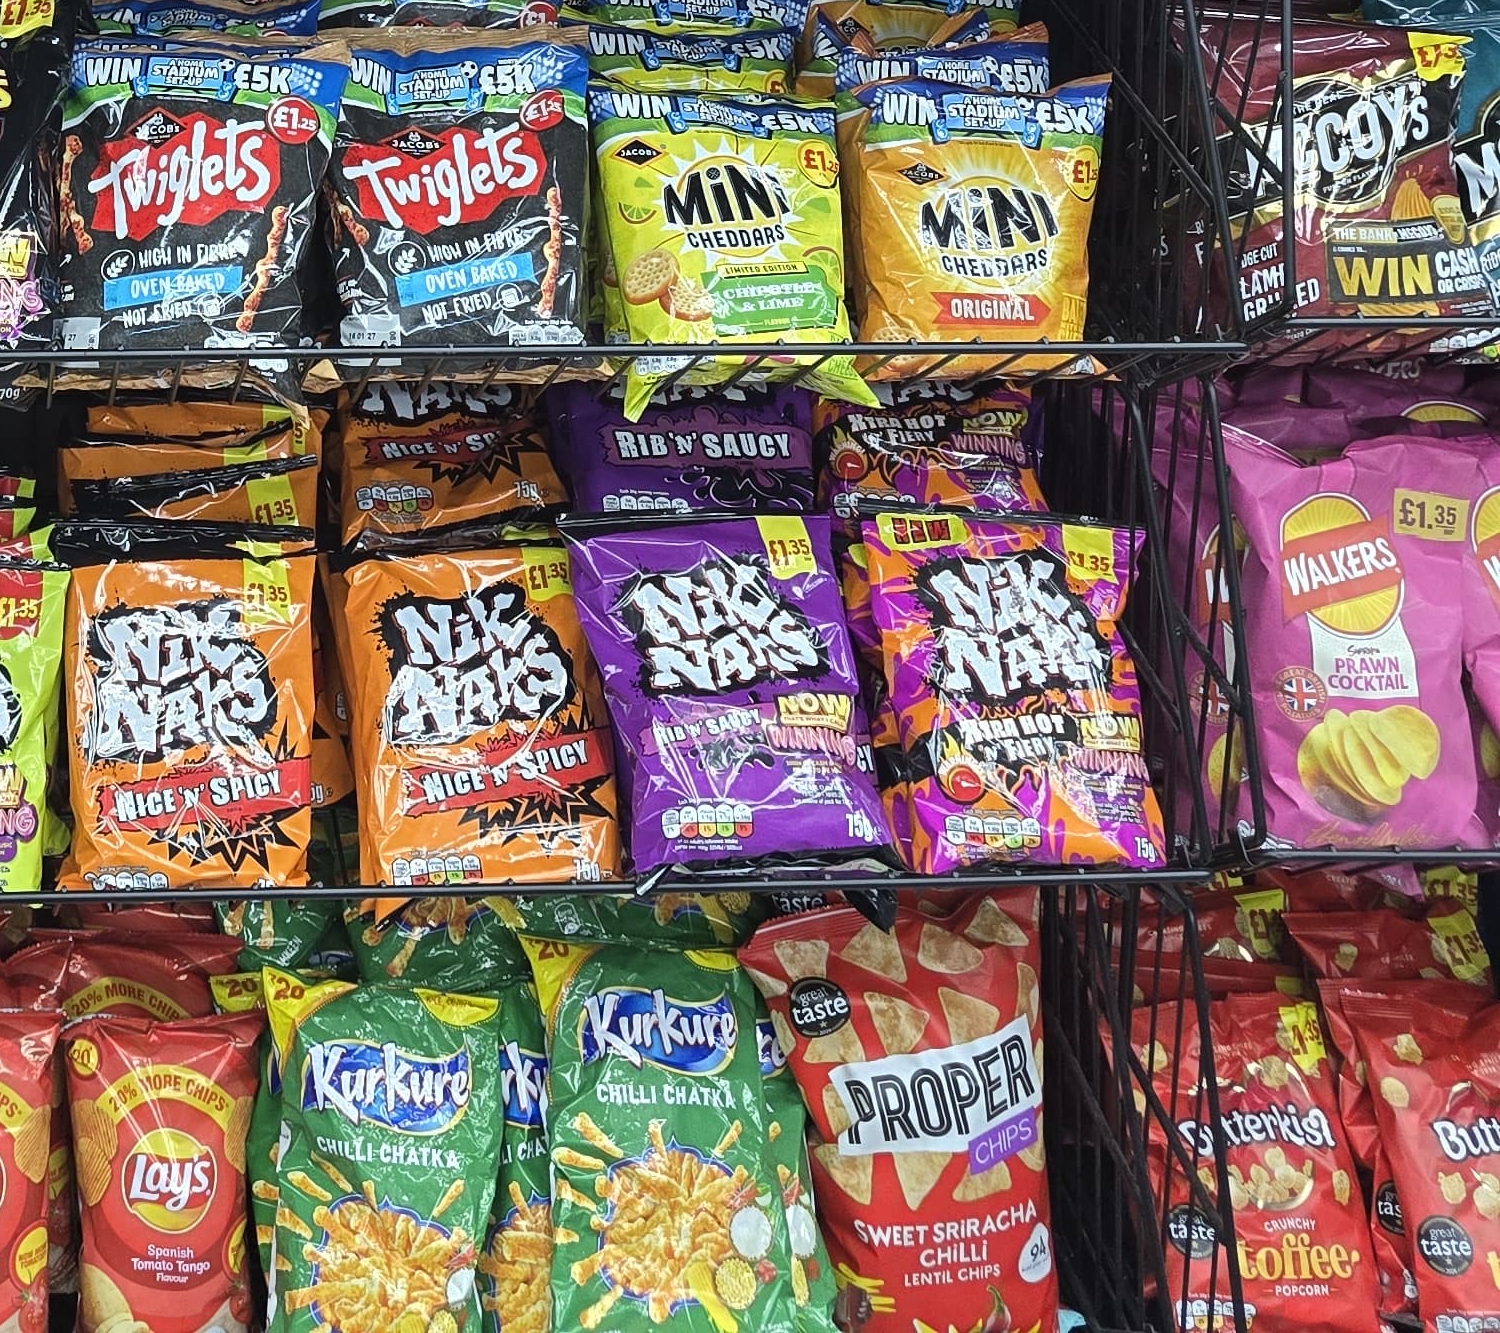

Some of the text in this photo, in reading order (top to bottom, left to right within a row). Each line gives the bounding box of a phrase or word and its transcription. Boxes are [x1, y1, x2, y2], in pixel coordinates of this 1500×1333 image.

[84, 57, 141, 86] WIN
[151, 64, 219, 82] STADIUM
[234, 66, 291, 94] £5K
[88, 119, 271, 239] Twiglets
[342, 124, 539, 230] Twiglets
[427, 237, 481, 264] HIGH IN
[686, 226, 785, 249] CHEDDARS
[424, 259, 518, 293] OVEN BAKED
[723, 262, 798, 276] LIMITED EDITION
[1435, 247, 1479, 276] CASH
[1333, 255, 1434, 299] WIN
[422, 293, 493, 325] NOT FRIED
[950, 297, 1035, 322] ORIGINAL
[614, 431, 791, 460] RIB SAUCY
[1399, 498, 1457, 532] £1.35
[768, 536, 811, 566] £1.35
[1283, 537, 1398, 597] WALKERS
[1334, 656, 1400, 674] PRAWN
[1328, 674, 1409, 692] COCKTAIL
[115, 770, 281, 822] NICE SPICY
[309, 1041, 470, 1125] Kurkure
[846, 1044, 1036, 1145] PROPER
[974, 1118, 1033, 1166] CHIPS
[380, 1145, 461, 1170] CHATKA
[1264, 1217, 1316, 1233] CRUNCHY
[957, 1262, 1000, 1280] CHIPS
[1275, 1284, 1330, 1298] POPCORN
